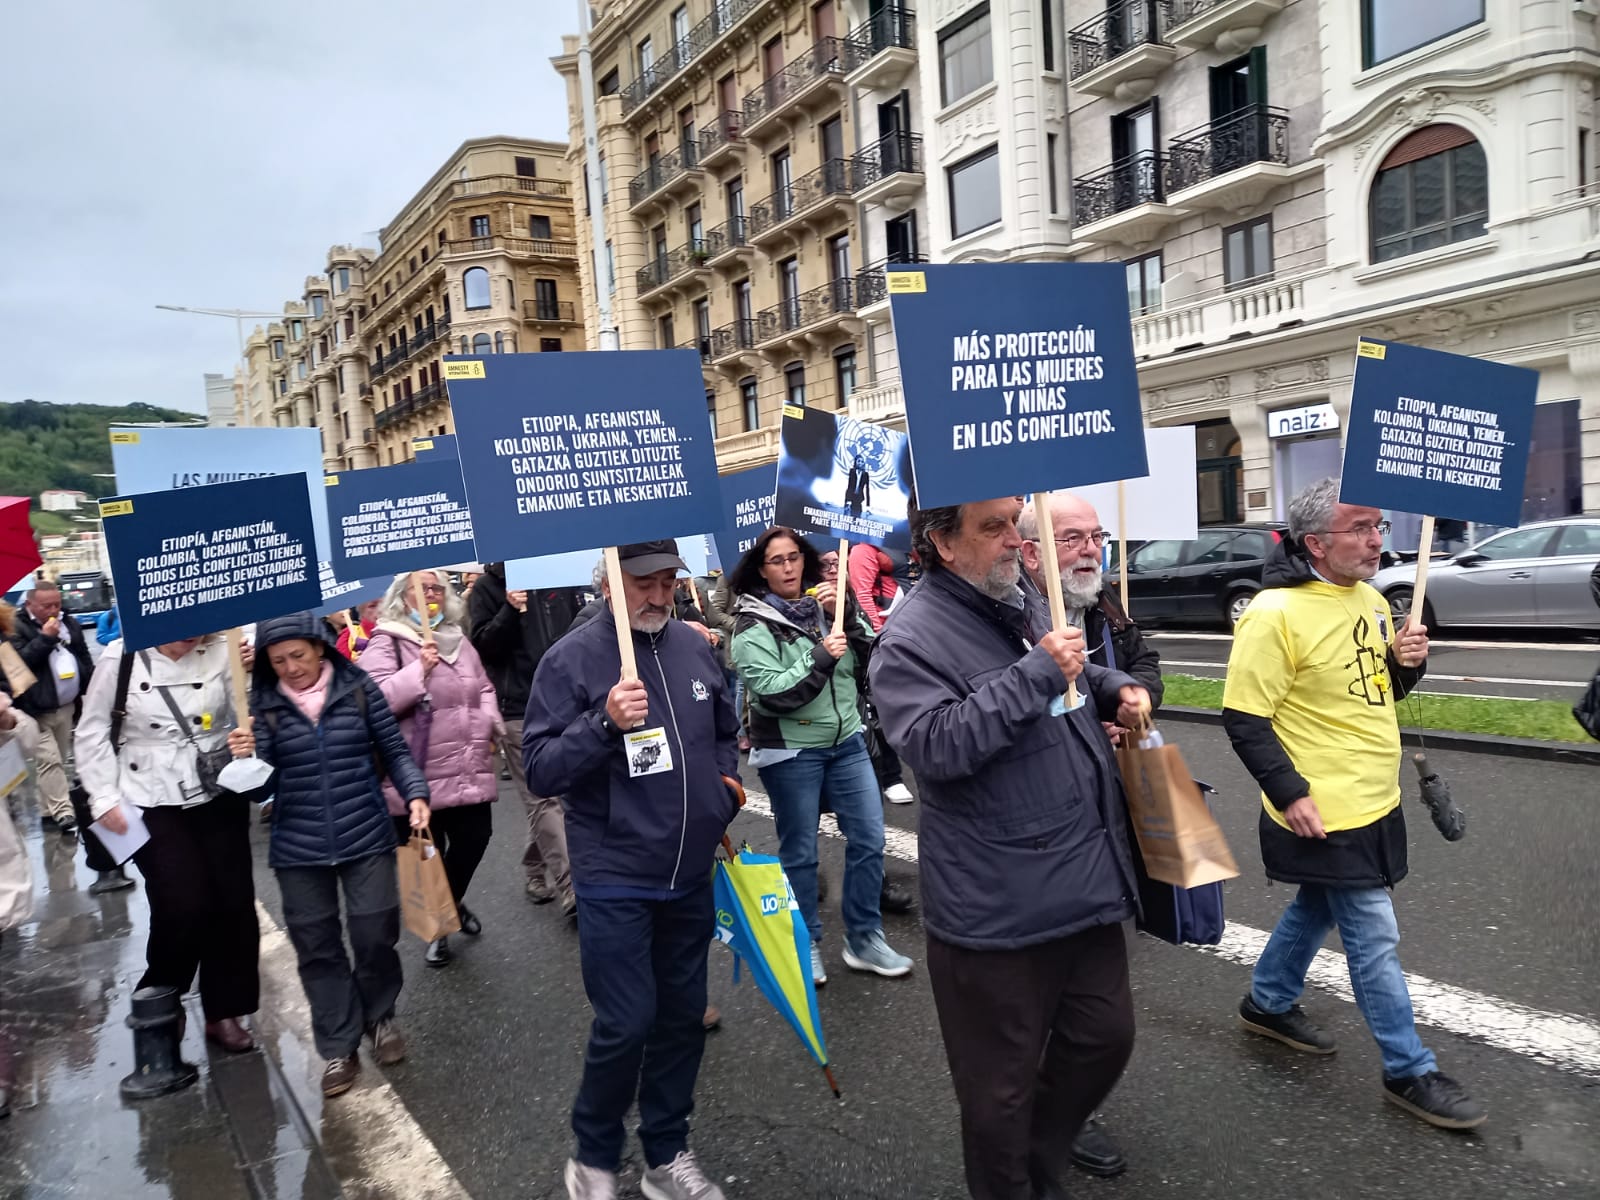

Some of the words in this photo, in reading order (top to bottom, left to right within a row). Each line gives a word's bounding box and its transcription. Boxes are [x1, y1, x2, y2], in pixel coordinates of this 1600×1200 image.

[954, 330, 990, 361] MÁS
[995, 325, 1095, 358] PROTECCIÓN
[952, 364, 996, 391] PARA
[1003, 361, 1031, 386] LAS
[1037, 356, 1103, 384] MUJERES
[1003, 392, 1014, 415] Y
[1020, 383, 1066, 414] NIÑAS
[1398, 397, 1438, 418] ETIOPIA,
[1441, 404, 1499, 429] AFGANISTAN,
[523, 414, 581, 434] ETIOPIA,
[585, 410, 665, 429] AFGANISTAN,
[953, 424, 976, 450] EN
[982, 420, 1012, 447] LOS
[1018, 410, 1115, 442] CONFLICTOS.
[1374, 409, 1424, 431] KOLONBIA,
[1428, 419, 1470, 439] UKRAINA,
[494, 436, 569, 456] KOLONBIA,
[572, 431, 632, 449] UKRAINA,
[1380, 443, 1424, 462] ONDORIO
[1426, 451, 1500, 475] SUNTSITZAILEAK
[1381, 429, 1422, 446] GATAZKA
[1425, 437, 1464, 453] GUZTIEK
[1466, 443, 1504, 459] DITUZTE
[511, 454, 570, 475] GATAZKA
[575, 450, 629, 468] GUZTIEK
[632, 445, 681, 463] DITUZTE
[1376, 459, 1423, 479] EMAKUME
[1426, 467, 1443, 481] ETA
[1445, 470, 1502, 491] NESKENTZAT.
[173, 473, 200, 488] LAS
[206, 473, 275, 484] MUJE
[516, 474, 578, 494] ONDORIO
[583, 464, 684, 488] SUNTSITZAILEAK
[517, 491, 584, 514] EMAKUME
[589, 488, 611, 506] ETA
[615, 481, 692, 503] NESKENTZAT.
[736, 499, 755, 515] MÁS
[343, 524, 371, 536] TODOS
[373, 521, 389, 532] LOS
[391, 514, 441, 529] CONFLICTOS
[736, 513, 761, 528] PARA
[763, 508, 774, 520] LA
[162, 531, 209, 552] ETIOPÍA,
[211, 520, 276, 542] AFGANISTÁN,
[343, 529, 413, 547] CONSECUENCIAS
[346, 546, 368, 558] PARA
[371, 543, 386, 554] LAS
[426, 537, 432, 546] Y
[434, 535, 448, 545] LAS
[739, 539, 751, 552] EN
[137, 551, 199, 572] COLOMBIA,
[202, 540, 251, 560] UCRANIA,
[138, 568, 176, 587] TODOS
[179, 562, 199, 579] LOS
[203, 552, 266, 574] CONFLICTOS
[269, 544, 302, 560] TIENEN
[139, 573, 230, 602] CONSECUENCIAS
[234, 557, 306, 581] DEVASTADORAS
[141, 599, 171, 616] PARA
[175, 593, 195, 610] LAS
[198, 582, 244, 605] MUJERES
[247, 580, 254, 593] Y
[256, 576, 274, 591] LAS
[277, 570, 307, 587] NIÑAS.
